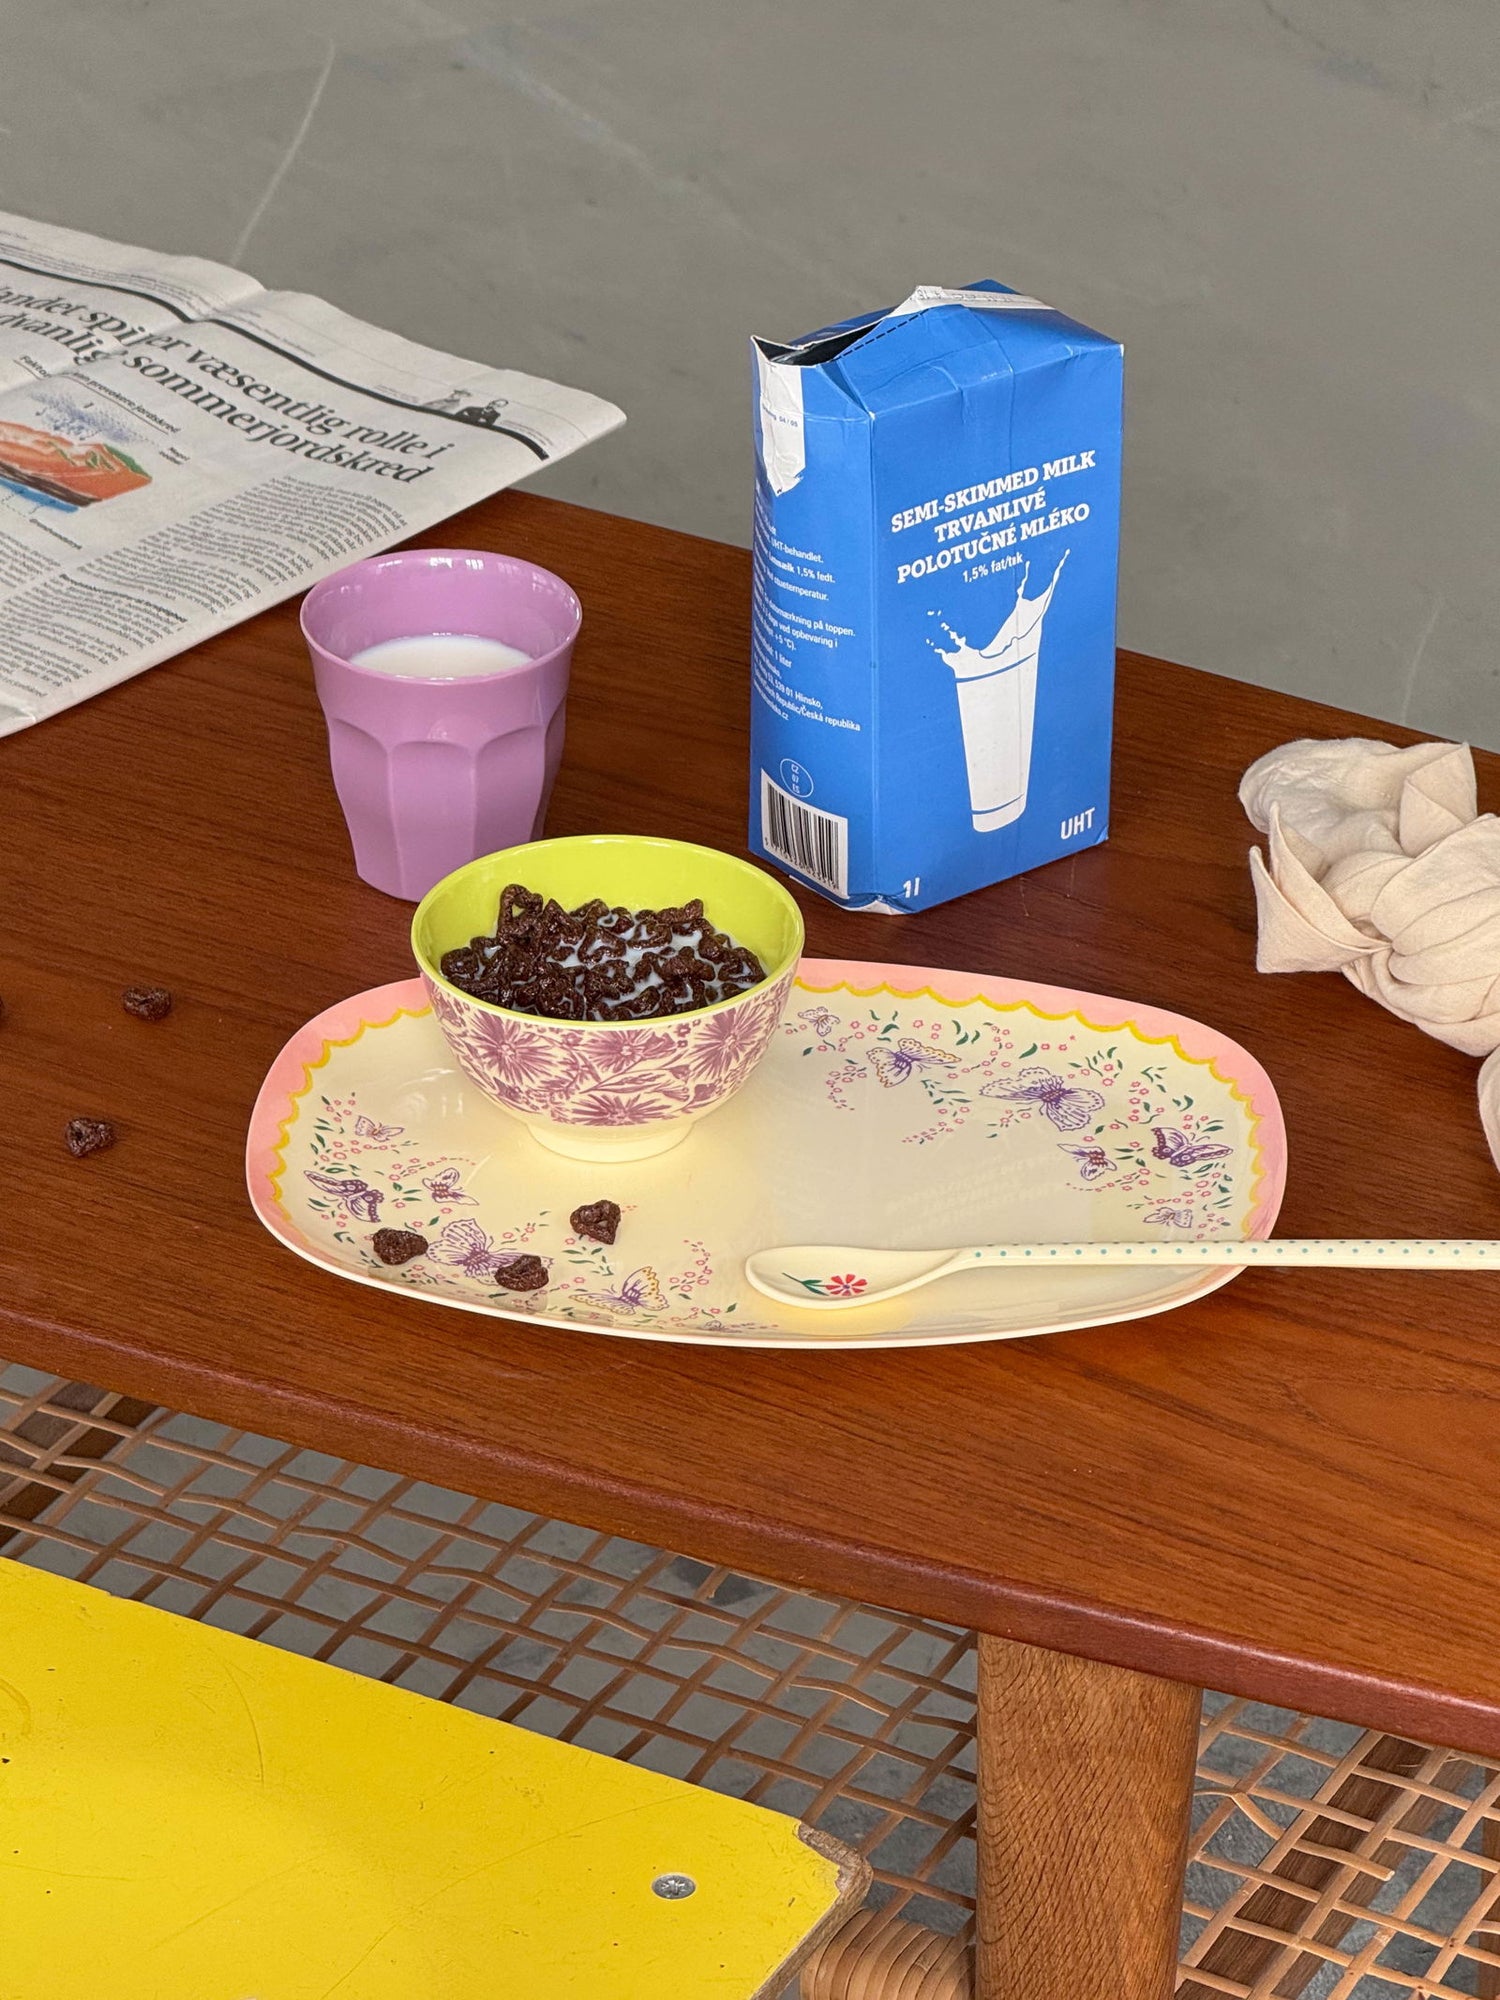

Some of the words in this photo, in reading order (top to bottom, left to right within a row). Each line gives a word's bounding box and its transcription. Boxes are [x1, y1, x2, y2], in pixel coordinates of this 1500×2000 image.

[187, 349, 352, 436] væsentlig
[341, 425, 429, 454] rolle
[422, 442, 455, 459] i
[122, 355, 435, 483] sommerjordskred
[890, 467, 1039, 533] SEMI-SKIMMED
[1042, 449, 1096, 481] MILK
[933, 485, 1047, 543] TRVANLIVÉ
[896, 521, 1017, 584] POLOTUČNÉ
[1019, 502, 1091, 541] MLÉKO
[796, 565, 816, 580] 1,5%
[816, 570, 836, 584] fedt.
[962, 563, 989, 583] 1,5%
[791, 628, 834, 649] opbevaring
[813, 619, 824, 631] på
[825, 623, 856, 638] toppen.
[795, 690, 823, 711] Hlinsko,
[824, 715, 861, 732] republika
[1060, 806, 1096, 841] UHT
